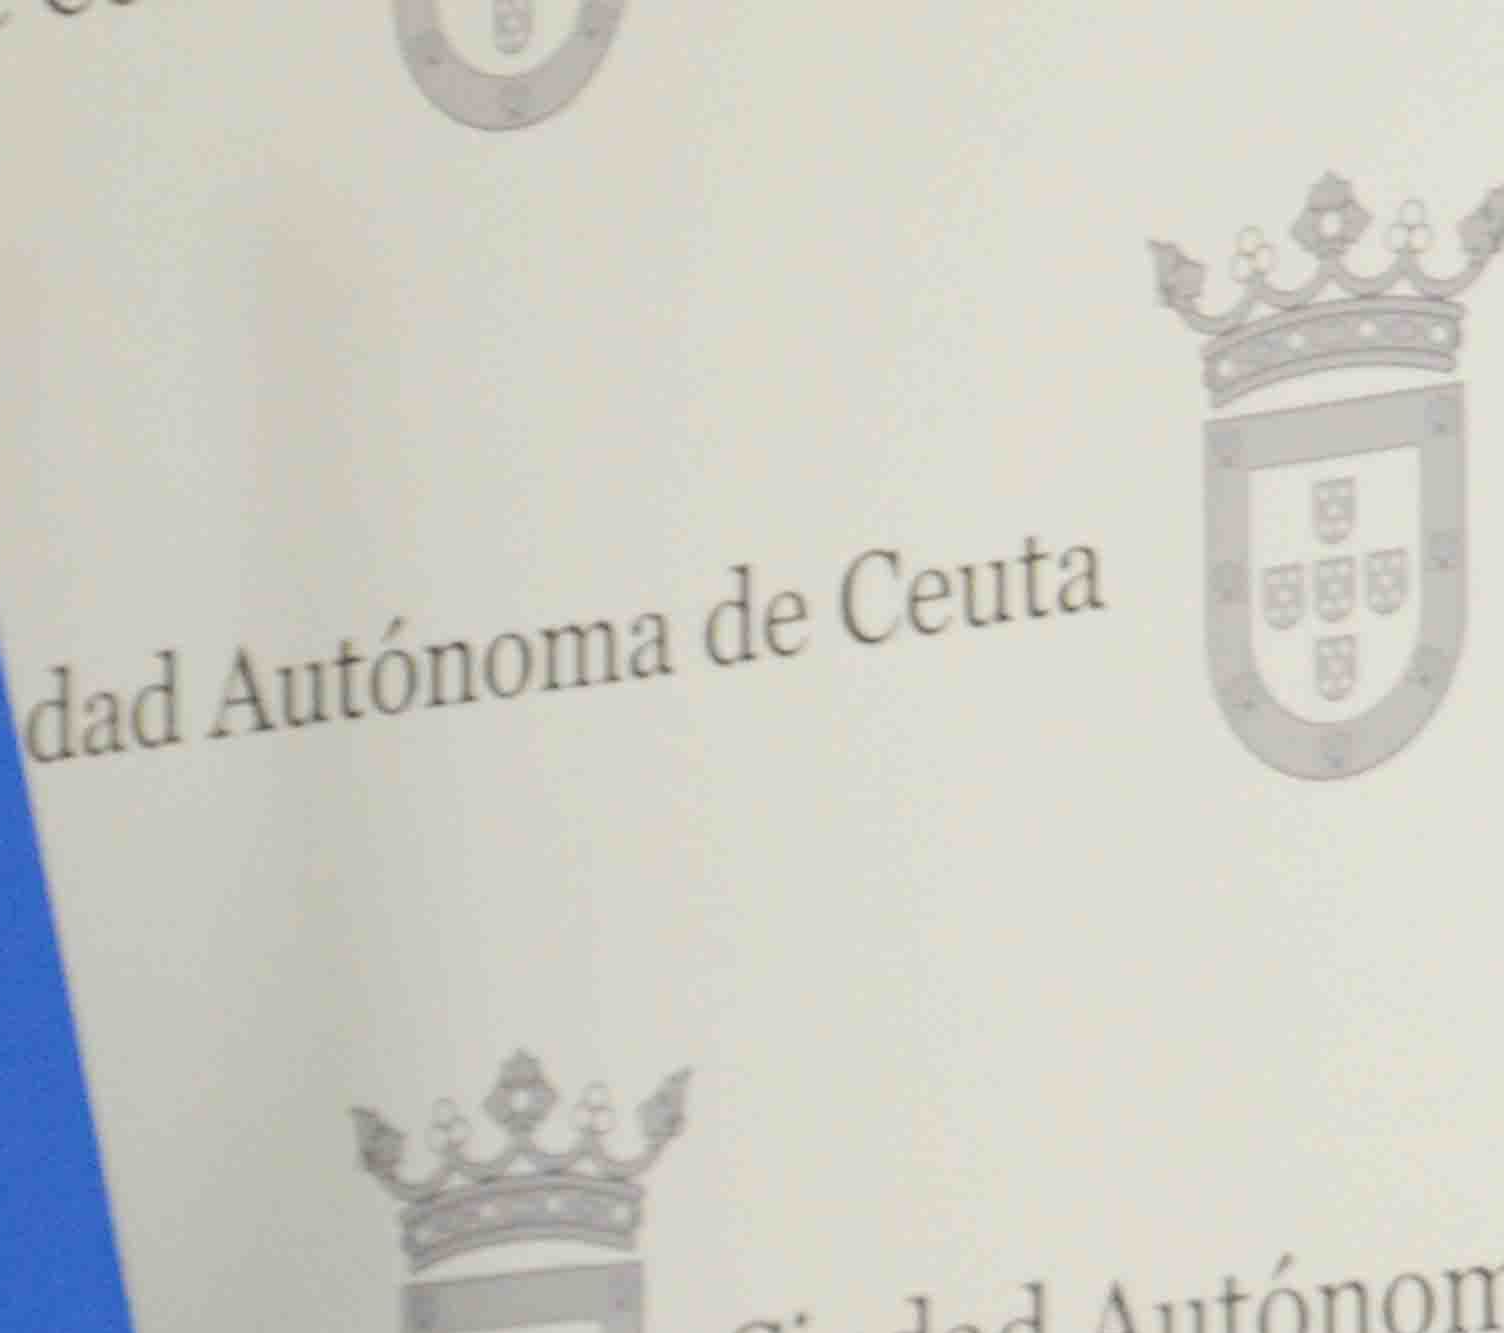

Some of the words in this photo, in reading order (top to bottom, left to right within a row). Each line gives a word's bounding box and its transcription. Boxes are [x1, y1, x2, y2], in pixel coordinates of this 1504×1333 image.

[207, 608, 674, 740] Autónoma
[704, 564, 810, 669] de
[839, 534, 1106, 647] Ceuta
